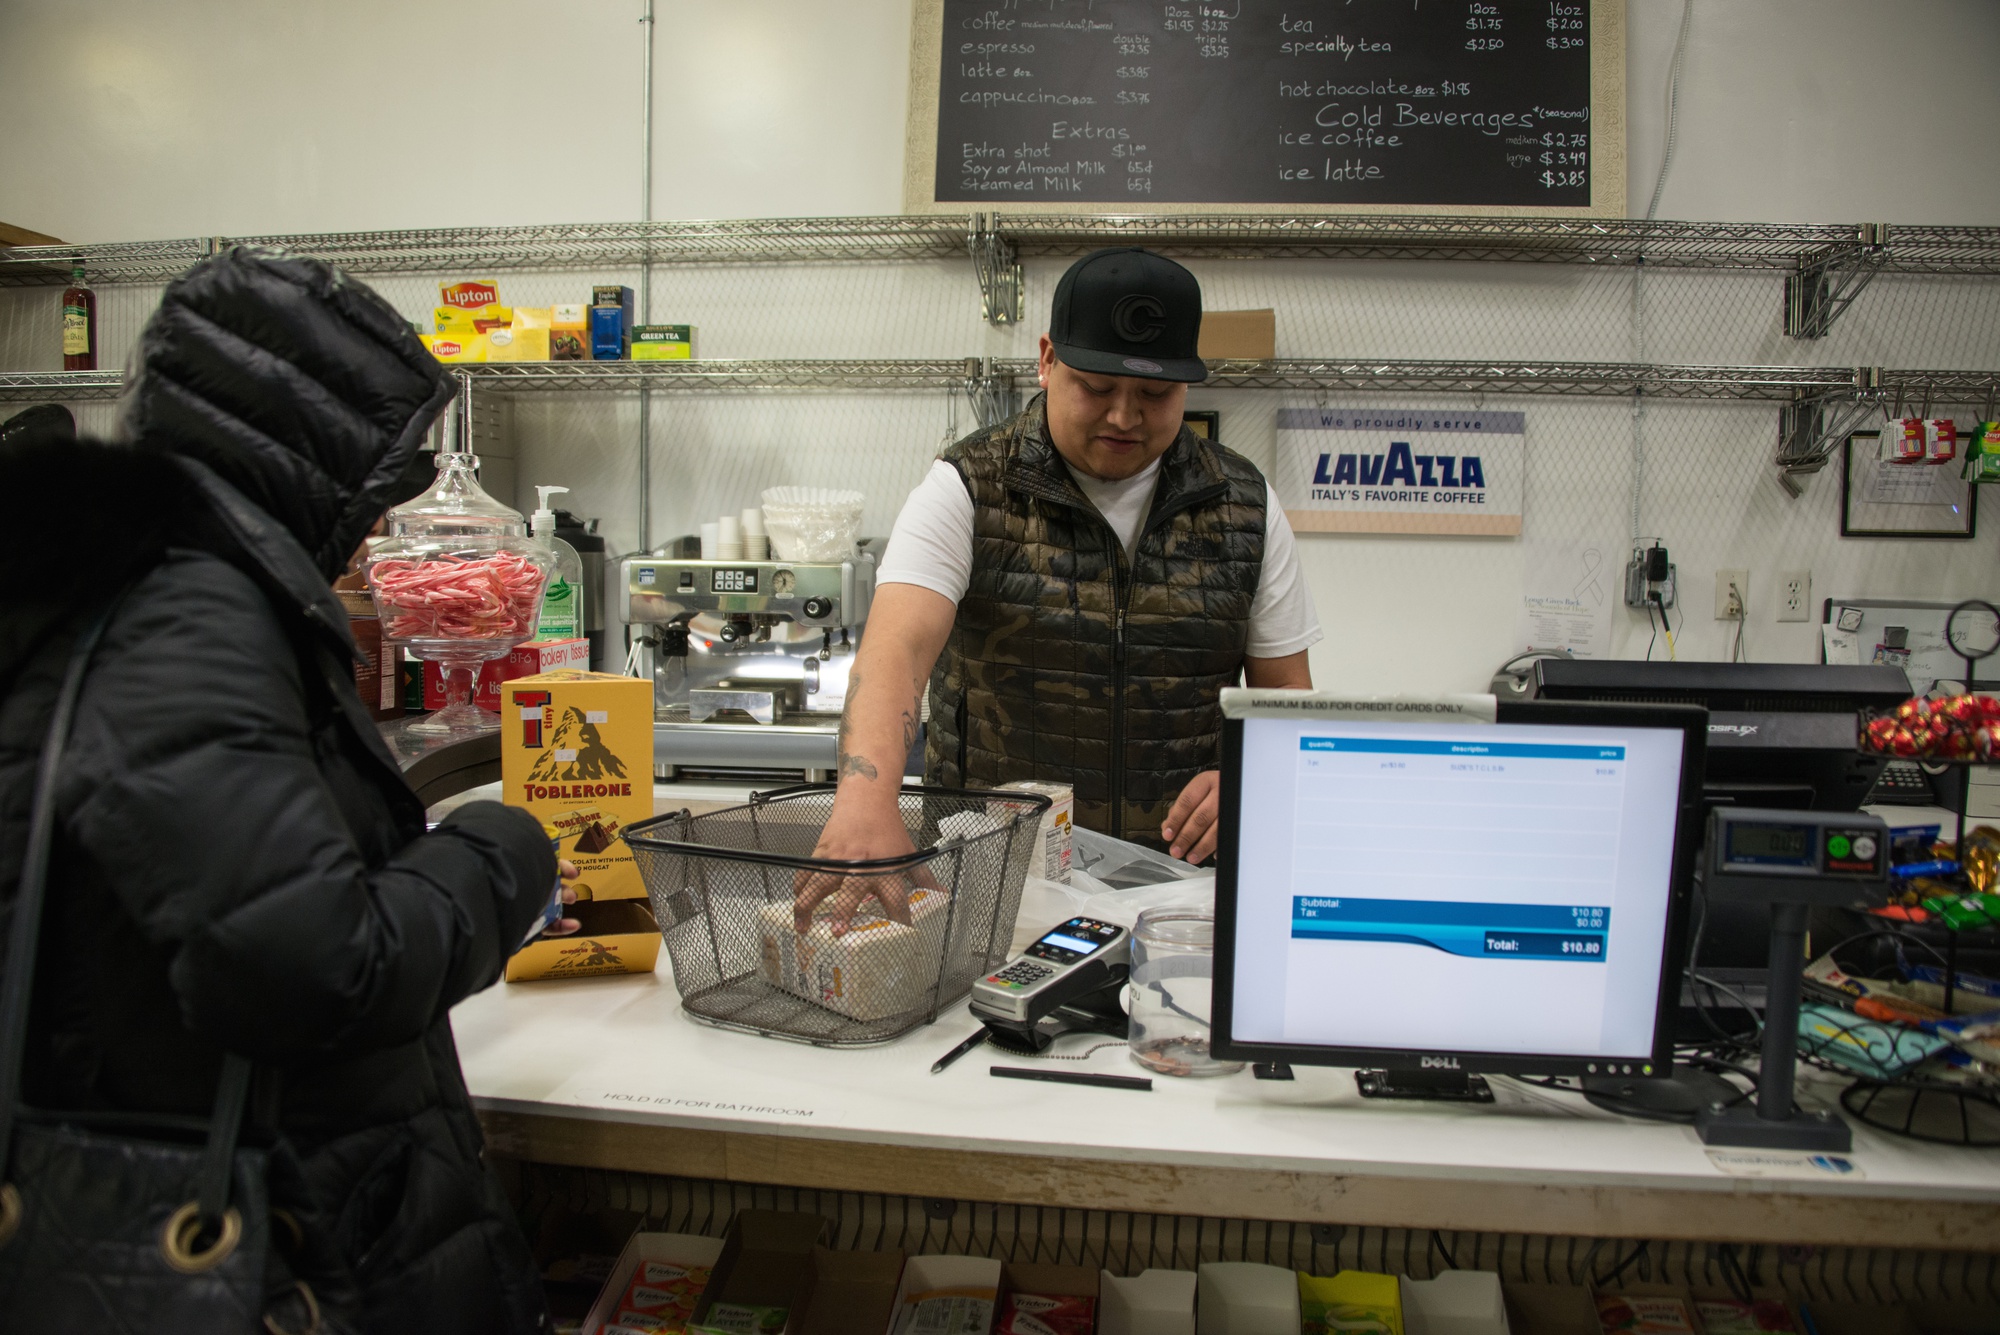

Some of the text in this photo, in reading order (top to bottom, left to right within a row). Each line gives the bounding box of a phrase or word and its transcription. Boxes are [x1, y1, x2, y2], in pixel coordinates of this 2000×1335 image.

[962, 11, 1016, 30] coffee
[1280, 13, 1313, 33] tea
[1466, 17, 1503, 30] $1.75
[1113, 33, 1228, 47] double triple
[961, 42, 1035, 60] espresso
[1280, 35, 1391, 61] specialty tea
[961, 61, 1008, 77] latte
[1280, 80, 1311, 97] hot
[1317, 78, 1413, 97] chocolate
[960, 88, 1072, 108] cappuccino
[1316, 103, 1382, 127] Cold
[1052, 121, 1130, 139] Extras
[1280, 126, 1402, 148] ice coffee
[1505, 135, 1538, 145] medium
[963, 141, 1005, 158] Extra
[1014, 142, 1051, 158] shot
[1507, 153, 1531, 168] large
[961, 160, 992, 180] Soy
[997, 165, 1011, 173] or
[1016, 160, 1069, 174] Almond
[1076, 161, 1105, 174] Milk
[1280, 158, 1384, 181] ice latte
[960, 178, 1034, 191] Steamed
[1045, 176, 1082, 192] Milk
[446, 290, 494, 306] Lipton
[434, 345, 460, 354] Lipton
[1320, 416, 1482, 430] We proudly serve
[1313, 442, 1485, 488] LAVAZZA
[1312, 489, 1485, 503] ITALY'S FAVORITE COFFEE
[510, 653, 532, 664] BT-6
[540, 643, 589, 667] bakery tissue
[1252, 700, 1463, 713] MINIMUM $5.00 FOR CREDIT CARDS ONLY
[544, 707, 554, 729] tiny
[1708, 725, 1758, 736] OSIFLEX
[1308, 741, 1335, 749] quantity
[1452, 745, 1488, 754] description
[524, 783, 631, 802] TOBLERONE
[553, 812, 601, 829] TOBLERONE
[1301, 898, 1341, 908] Subtotal:
[1572, 907, 1603, 918] $10.80
[1577, 918, 1602, 928] $0.00
[1487, 939, 1600, 953] Total: $10.80
[1421, 1056, 1461, 1069] DELL
[603, 1093, 650, 1103] HOLD
[675, 1099, 710, 1108] FOR
[714, 1102, 814, 1117] BATHROOM
[647, 1267, 685, 1278] Trident
[635, 1291, 674, 1301] Trident
[1016, 1299, 1056, 1309] Trident
[718, 1307, 755, 1318] Trident
[622, 1315, 661, 1327] Trident
